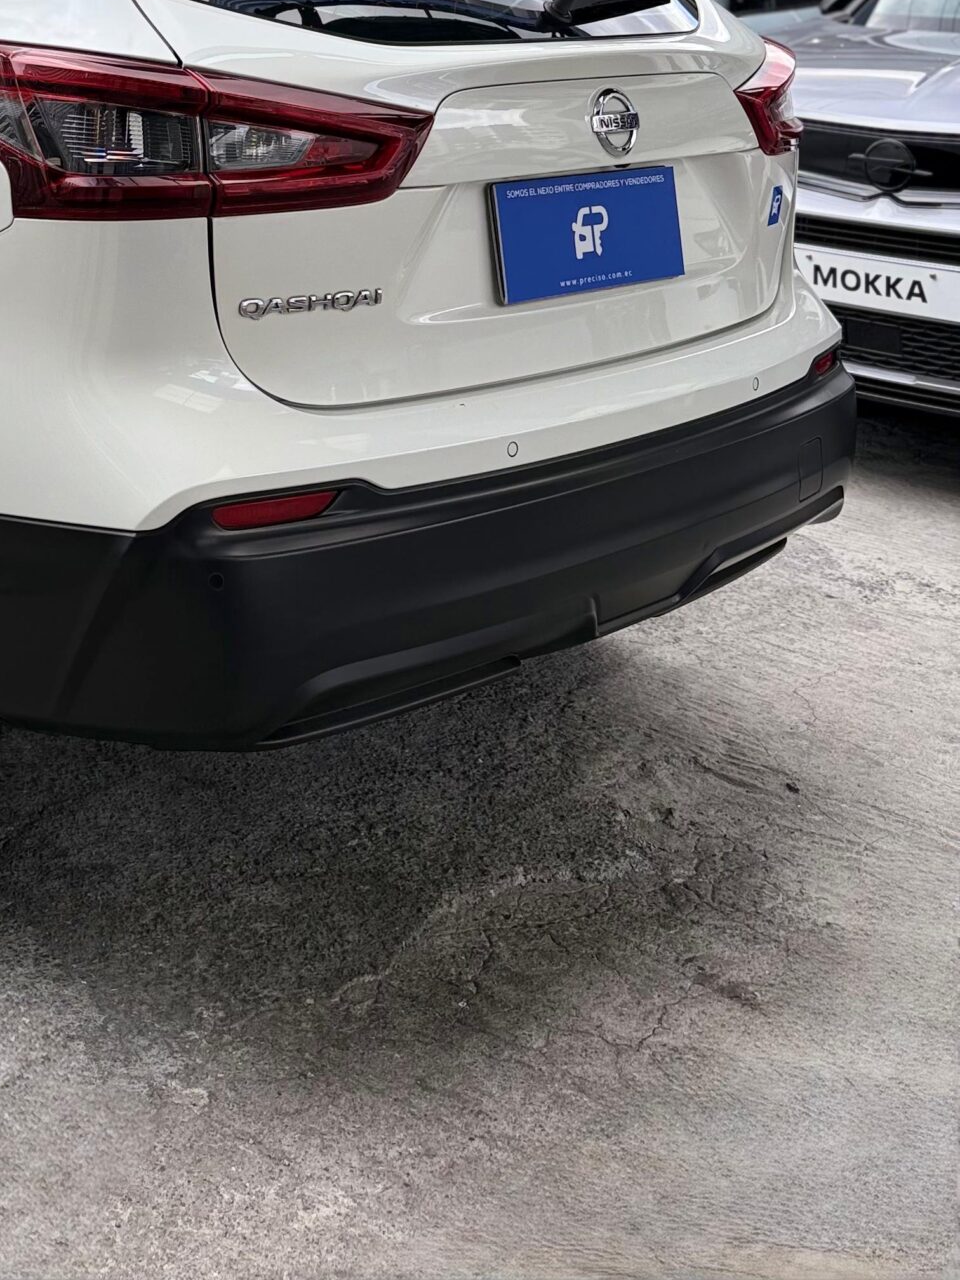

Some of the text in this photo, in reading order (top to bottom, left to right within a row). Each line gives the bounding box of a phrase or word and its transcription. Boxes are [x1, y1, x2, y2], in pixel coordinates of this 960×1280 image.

[506, 187, 529, 199] SOMOS
[529, 187, 537, 196] EL
[537, 186, 554, 195] NEXO
[555, 183, 575, 194] ENTRE
[574, 179, 620, 191] COMPRADORES
[624, 174, 665, 186] VENDEDORES
[559, 270, 633, 288] www.preciso.com.ec
[813, 264, 928, 304] MOKKA
[238, 287, 383, 321] QASHQAI
